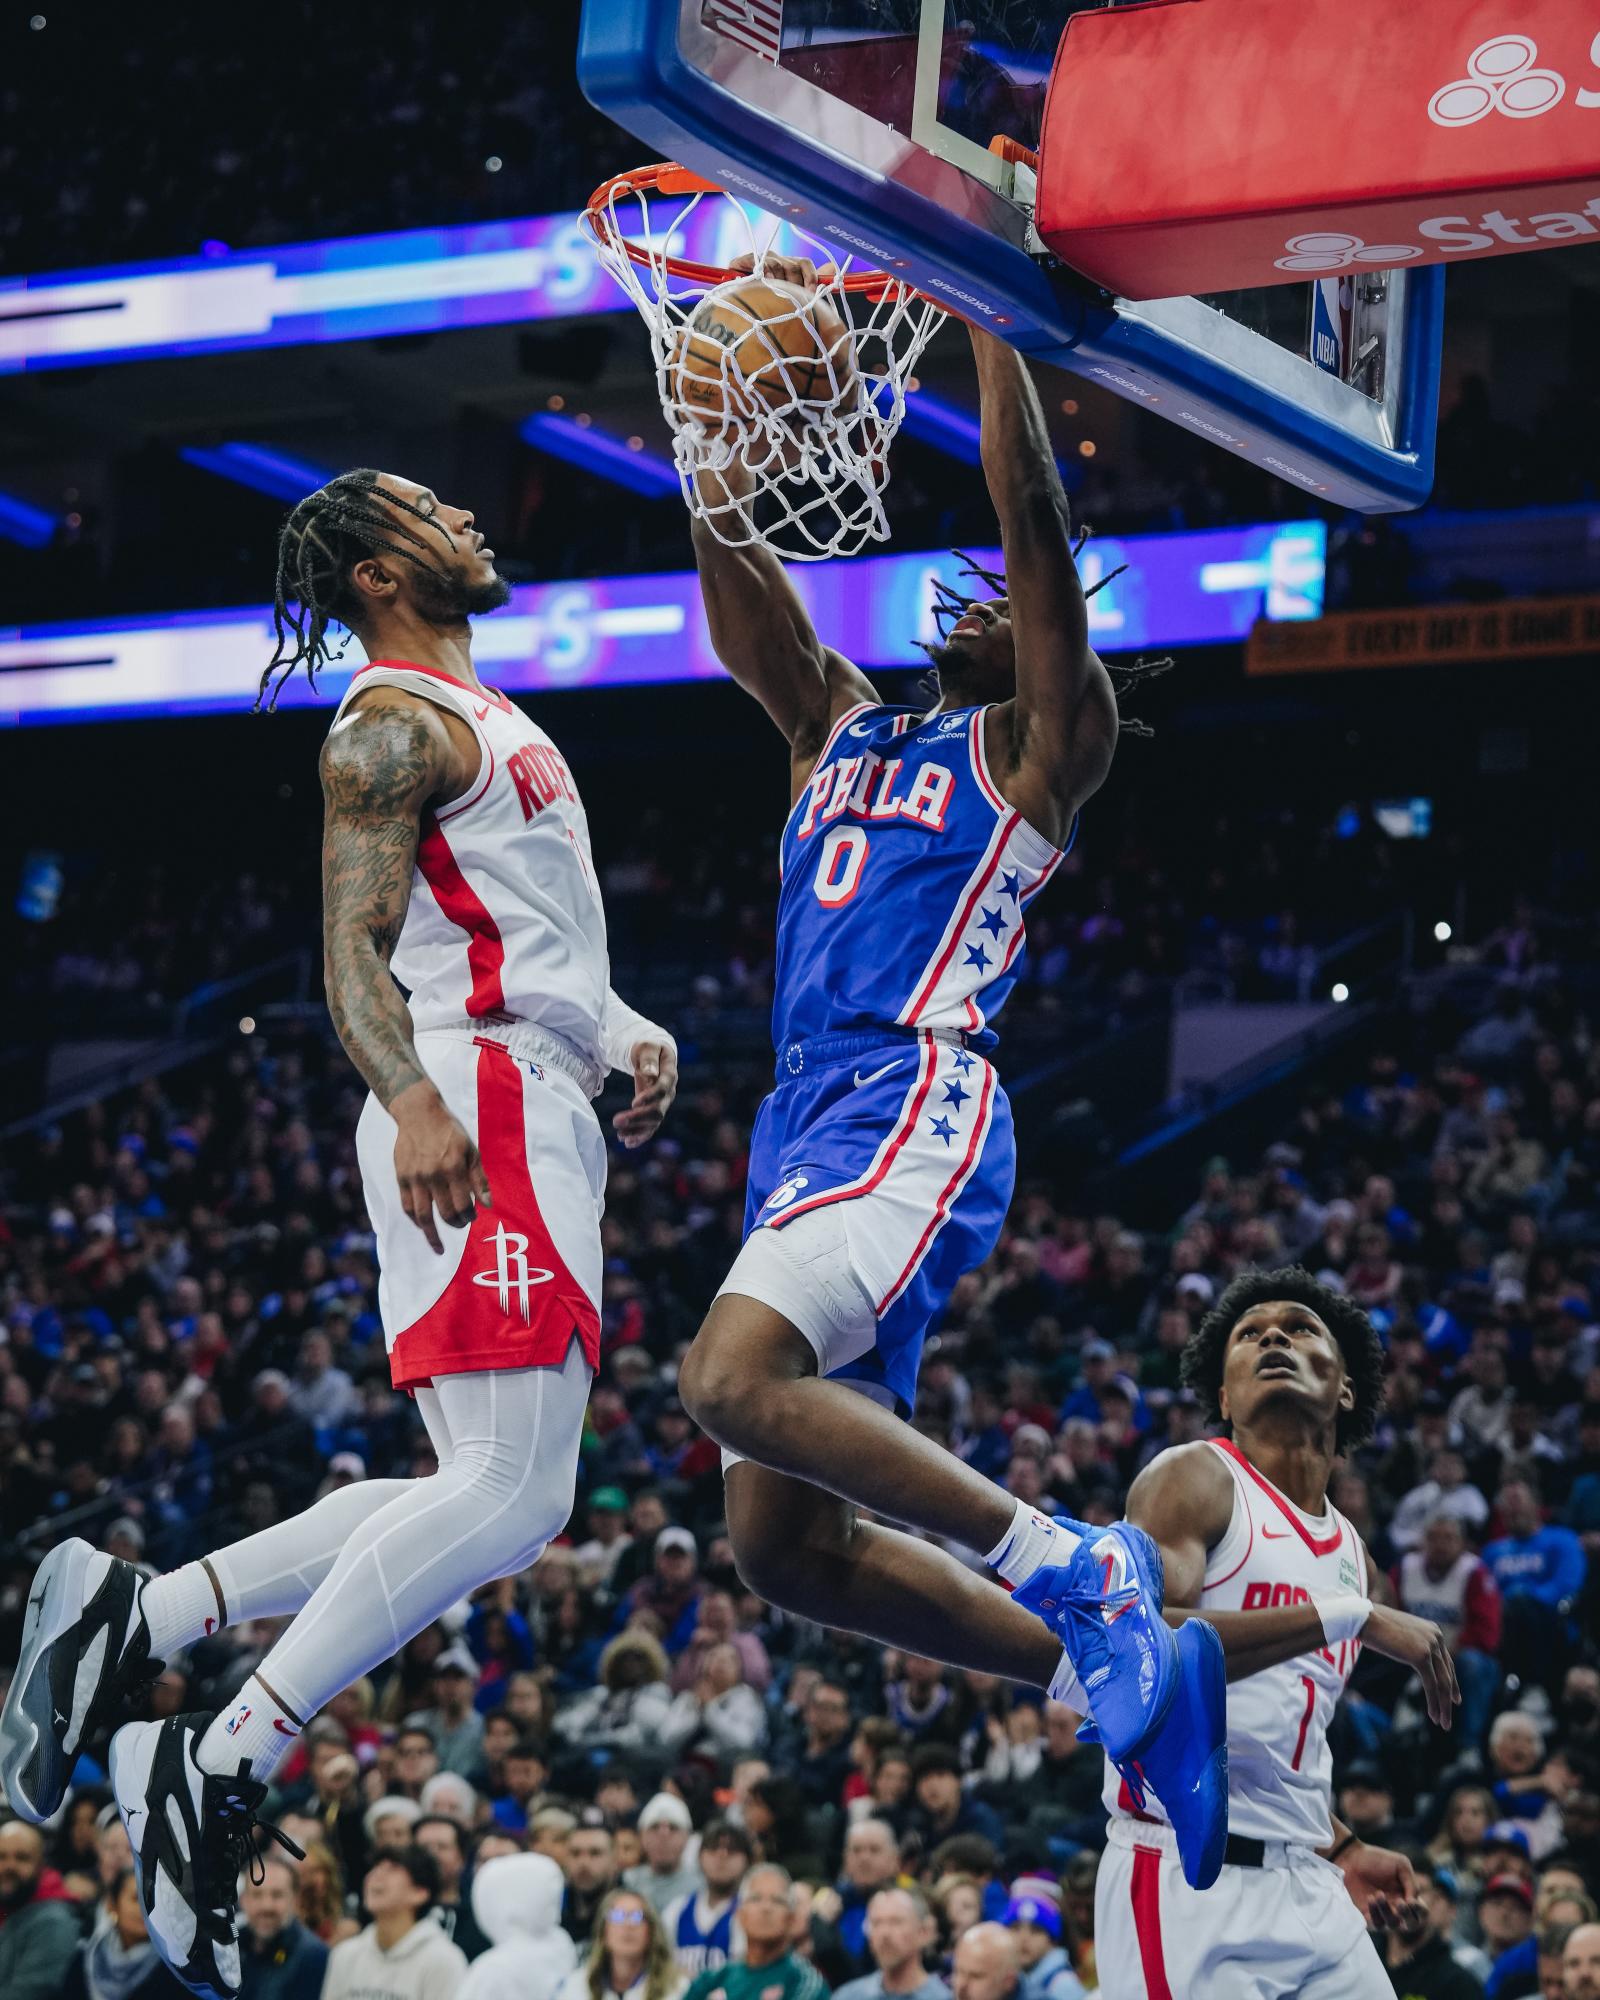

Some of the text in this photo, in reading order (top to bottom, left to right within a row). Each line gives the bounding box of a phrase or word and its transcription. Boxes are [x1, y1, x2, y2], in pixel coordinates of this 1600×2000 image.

[823, 224, 896, 261] POKERSTARS
[927, 277, 997, 316] POKERSTARS
[1316, 331, 1336, 368] NBA
[1089, 367, 1151, 398] POKERSTARS
[1177, 411, 1238, 443] POKERSTARS
[798, 748, 956, 841] PHILA
[813, 824, 870, 910] 0
[1291, 1674, 1316, 1772] 1
